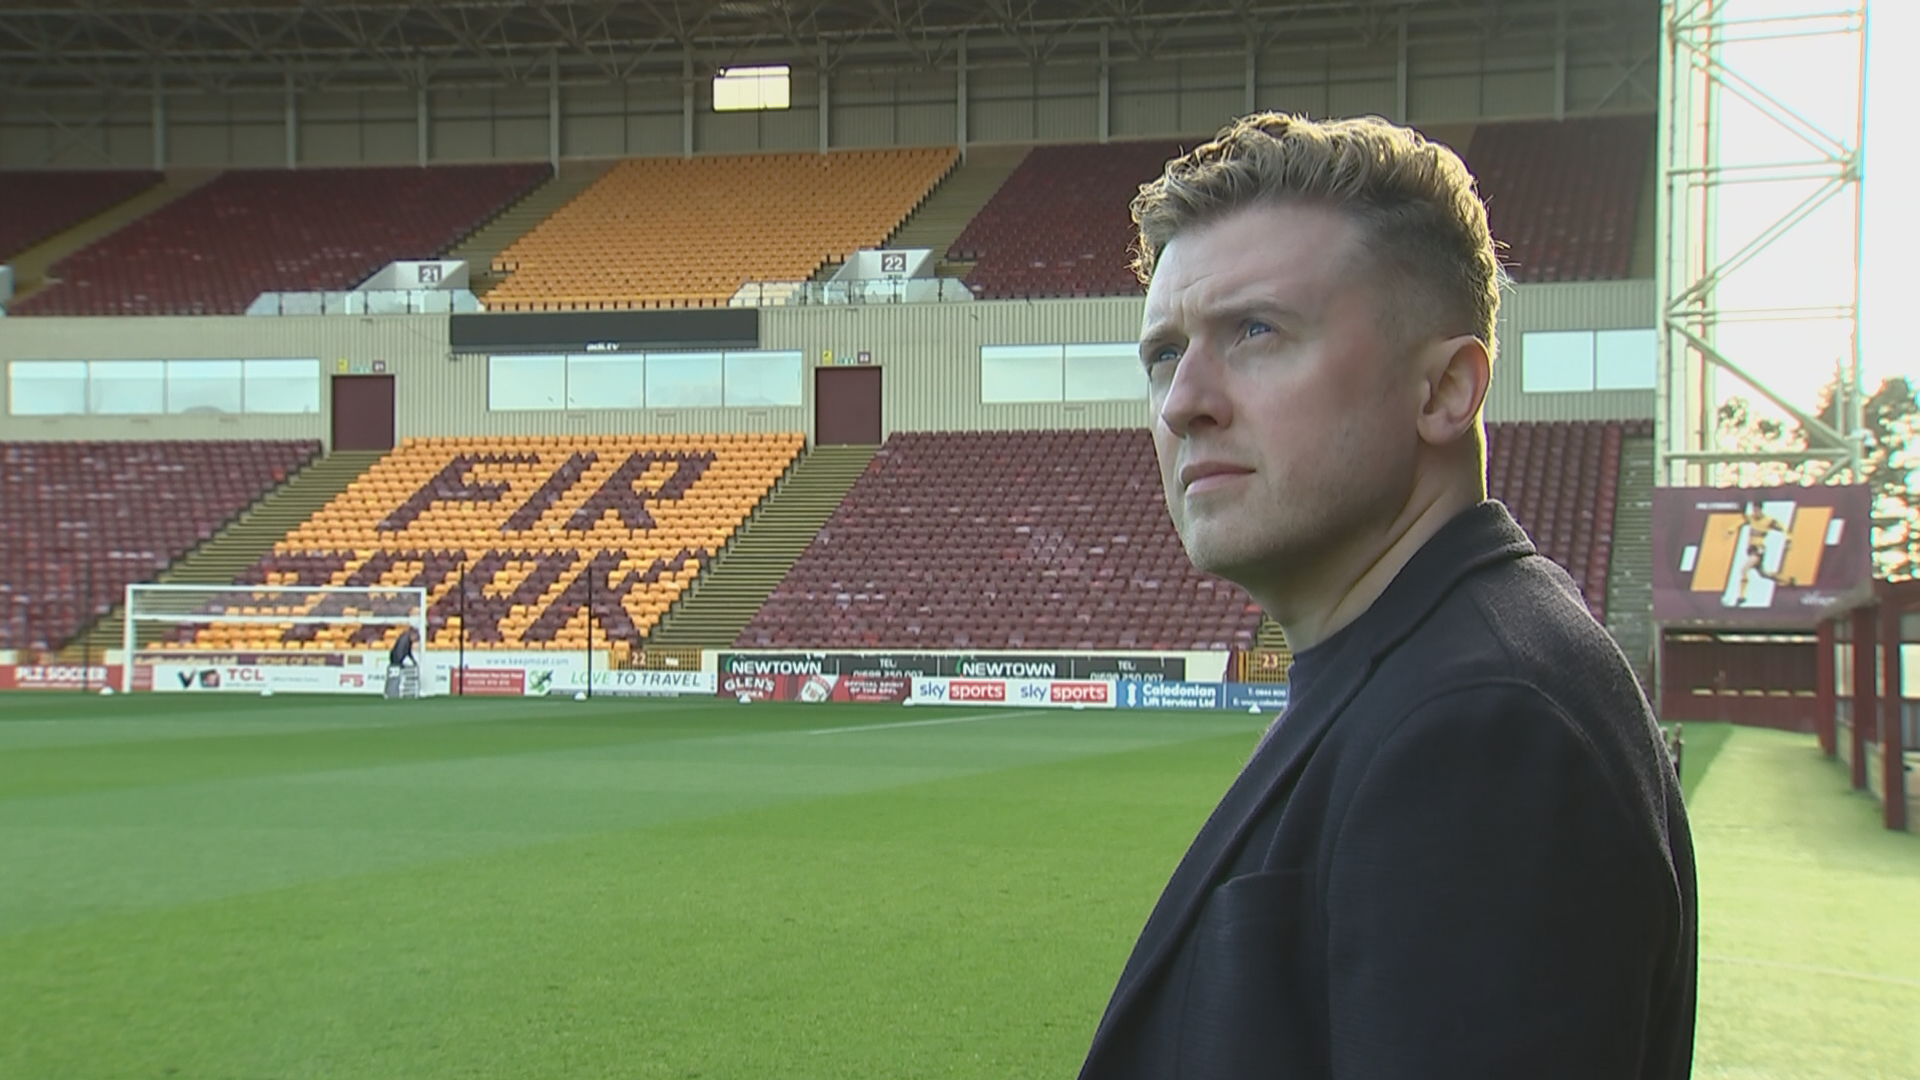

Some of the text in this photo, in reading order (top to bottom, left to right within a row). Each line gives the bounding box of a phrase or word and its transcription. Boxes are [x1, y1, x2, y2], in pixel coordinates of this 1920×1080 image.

[884, 256, 903, 271] 22
[422, 268, 438, 282] 21
[375, 450, 717, 532] FIR
[631, 652, 647, 665] 22
[1262, 654, 1279, 668] 23
[227, 668, 264, 682] TCL
[732, 661, 822, 675] NEWTOWN
[962, 661, 1056, 677] NEWTOWN
[570, 670, 610, 685] LOVE
[617, 672, 636, 686] TO
[641, 672, 701, 687] TRAVEL
[724, 676, 775, 692] GLEN'S
[920, 680, 1005, 700] sky sports
[1020, 682, 1106, 702] sky sports
[1142, 683, 1216, 697] Caledonian
[1142, 697, 1216, 708] Lift Services Ltd
